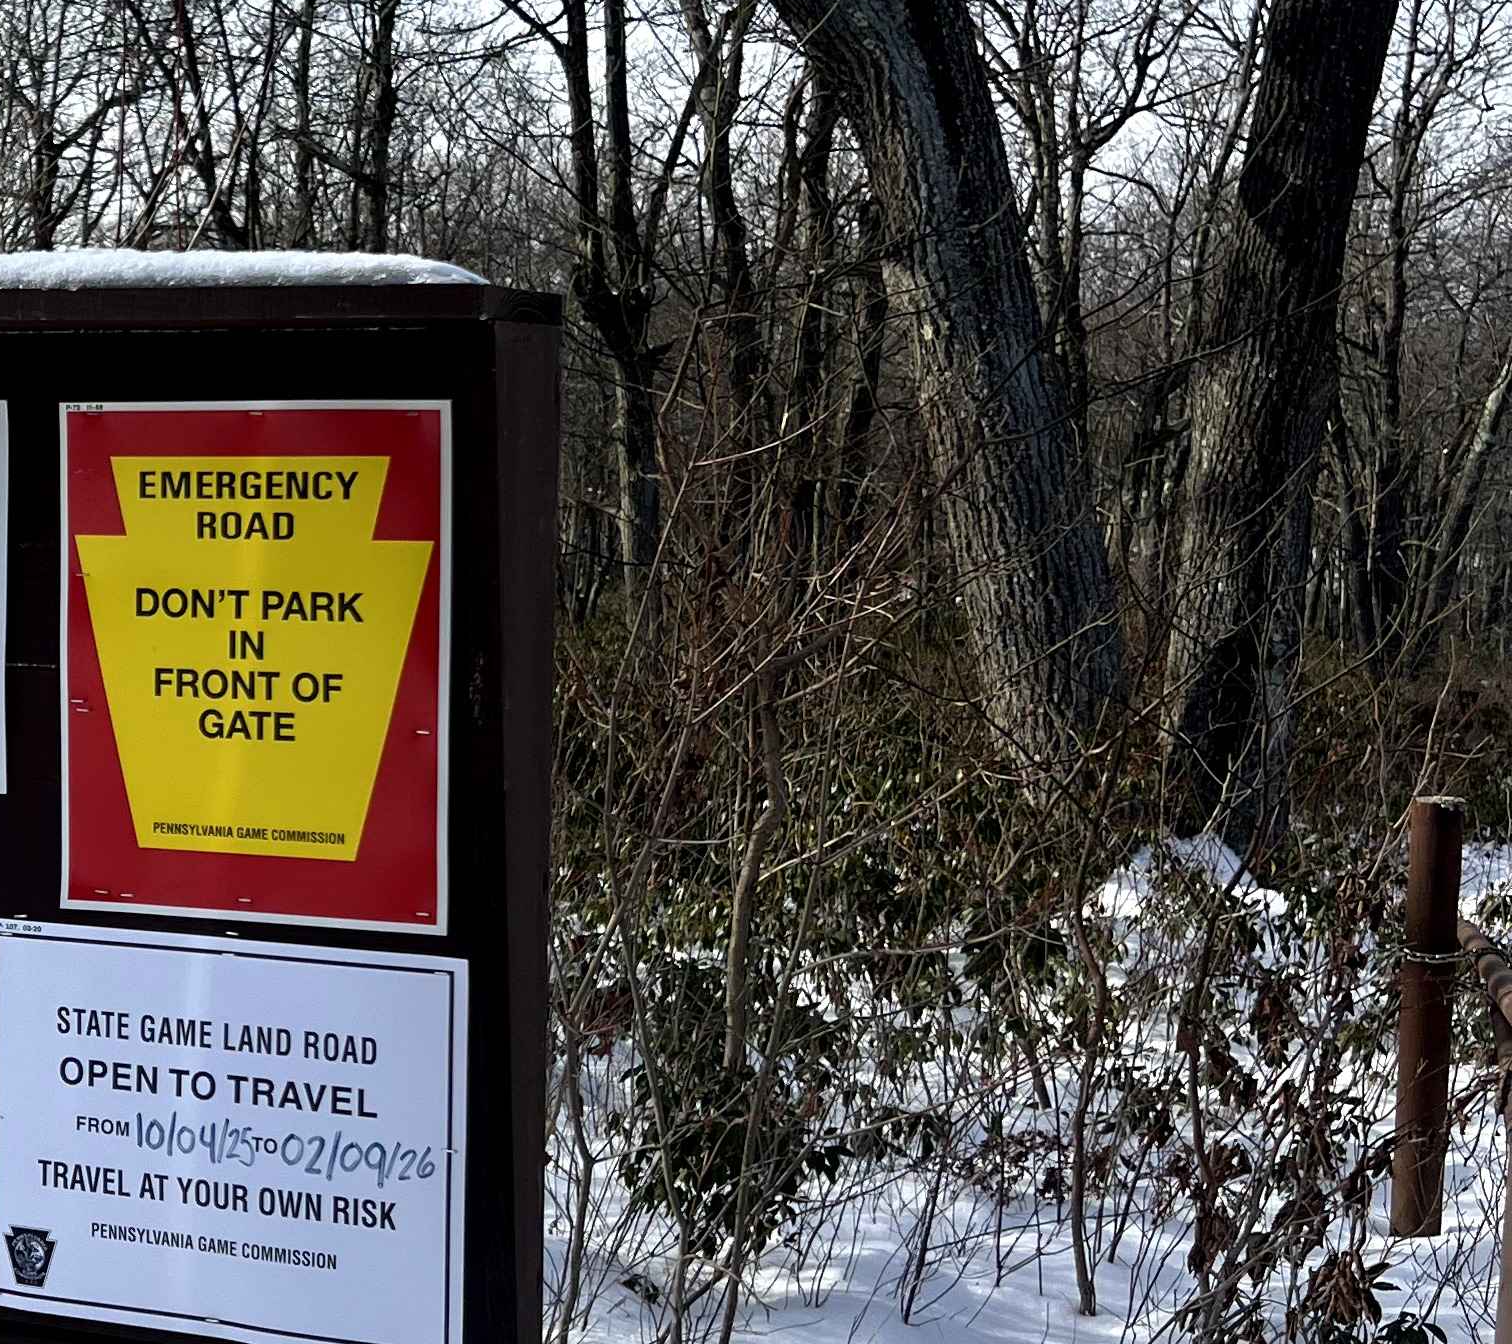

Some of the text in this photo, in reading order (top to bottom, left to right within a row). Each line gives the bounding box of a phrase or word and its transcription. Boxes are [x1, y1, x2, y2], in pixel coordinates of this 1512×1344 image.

[140, 471, 359, 500] EMERGENCY
[197, 511, 295, 540] ROAD
[135, 587, 364, 623] DON'T PARK
[229, 631, 264, 660] IN
[154, 668, 343, 703] FRONT OF
[199, 710, 296, 741] GATE
[153, 821, 345, 845] PENNSYLVANIA GAME COMMISSION
[57, 1006, 377, 1065] STATE GAME LAND ROAD
[60, 1057, 378, 1118] OPEN TO TRAVEL
[76, 1115, 129, 1137] FROM
[255, 1136, 278, 1154] TO
[281, 1131, 436, 1188] 02/09/26
[38, 1159, 396, 1231] TRAVEL AT YOUR OWN RISK
[91, 1222, 337, 1269] PENNSYLVANIA GAME COMMISSION
